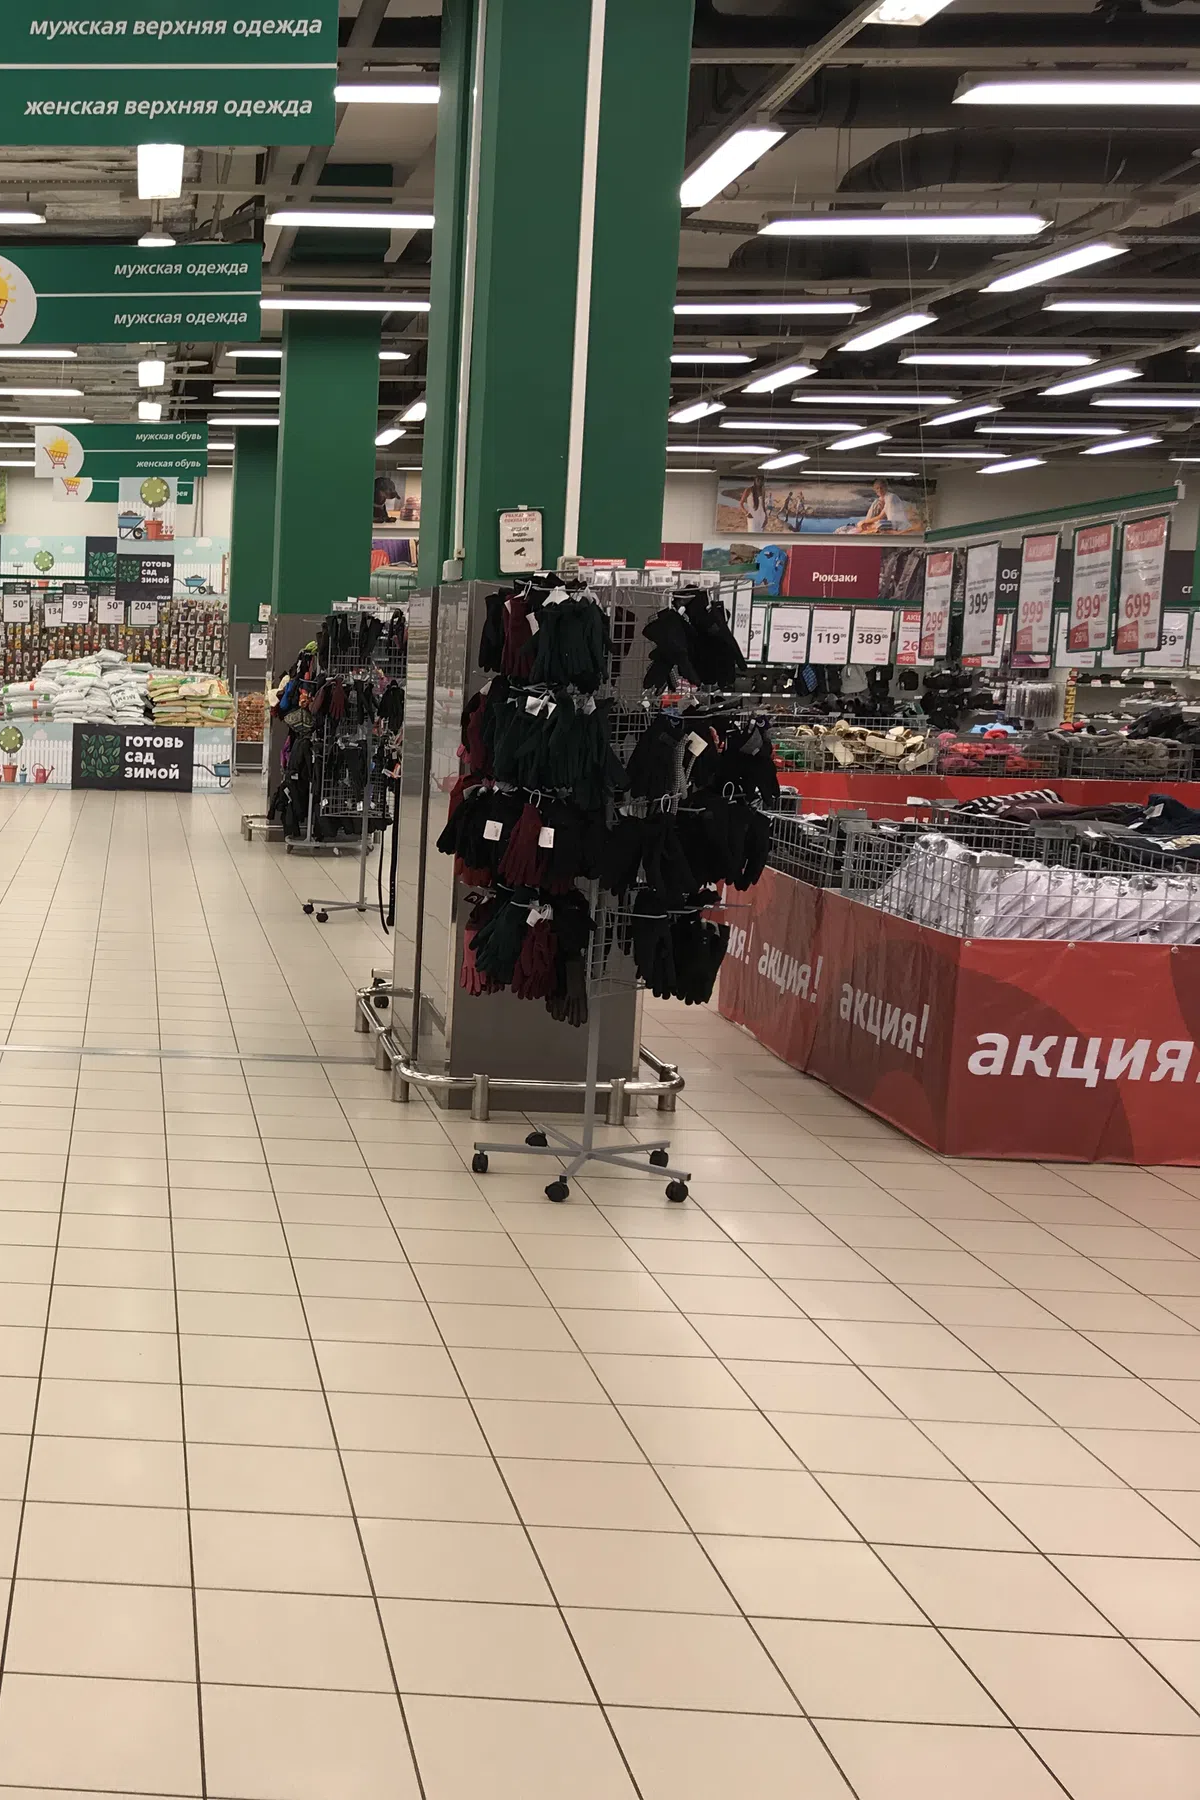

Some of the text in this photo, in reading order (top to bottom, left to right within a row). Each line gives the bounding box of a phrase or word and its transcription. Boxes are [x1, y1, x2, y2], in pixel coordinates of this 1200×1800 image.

[29, 17, 323, 40] мужская верхняя одежда
[23, 98, 313, 119] женская верхняя одежда
[113, 262, 249, 278] мужская одежда
[113, 312, 248, 327] мужская одежда
[135, 431, 202, 442] мужская обувь
[136, 459, 202, 469] женская обувь
[141, 560, 172, 568] готовь
[141, 569, 157, 577] сад
[812, 571, 858, 583] Рюкзаки
[141, 576, 170, 584] зимой
[13, 600, 24, 608] 50
[72, 600, 83, 609] 99
[107, 601, 118, 610] 50
[134, 602, 152, 610] 204
[968, 592, 988, 615] 399
[1075, 594, 1101, 620] 899
[1125, 592, 1150, 619] 699
[783, 631, 799, 643] 99
[817, 633, 840, 644] 119
[857, 633, 882, 645] 389
[125, 735, 184, 748] готовь
[124, 751, 155, 765] сад
[124, 764, 180, 780] зимой
[757, 942, 823, 1004] акция!
[839, 982, 930, 1060] акция!
[967, 1032, 1200, 1089] акция
